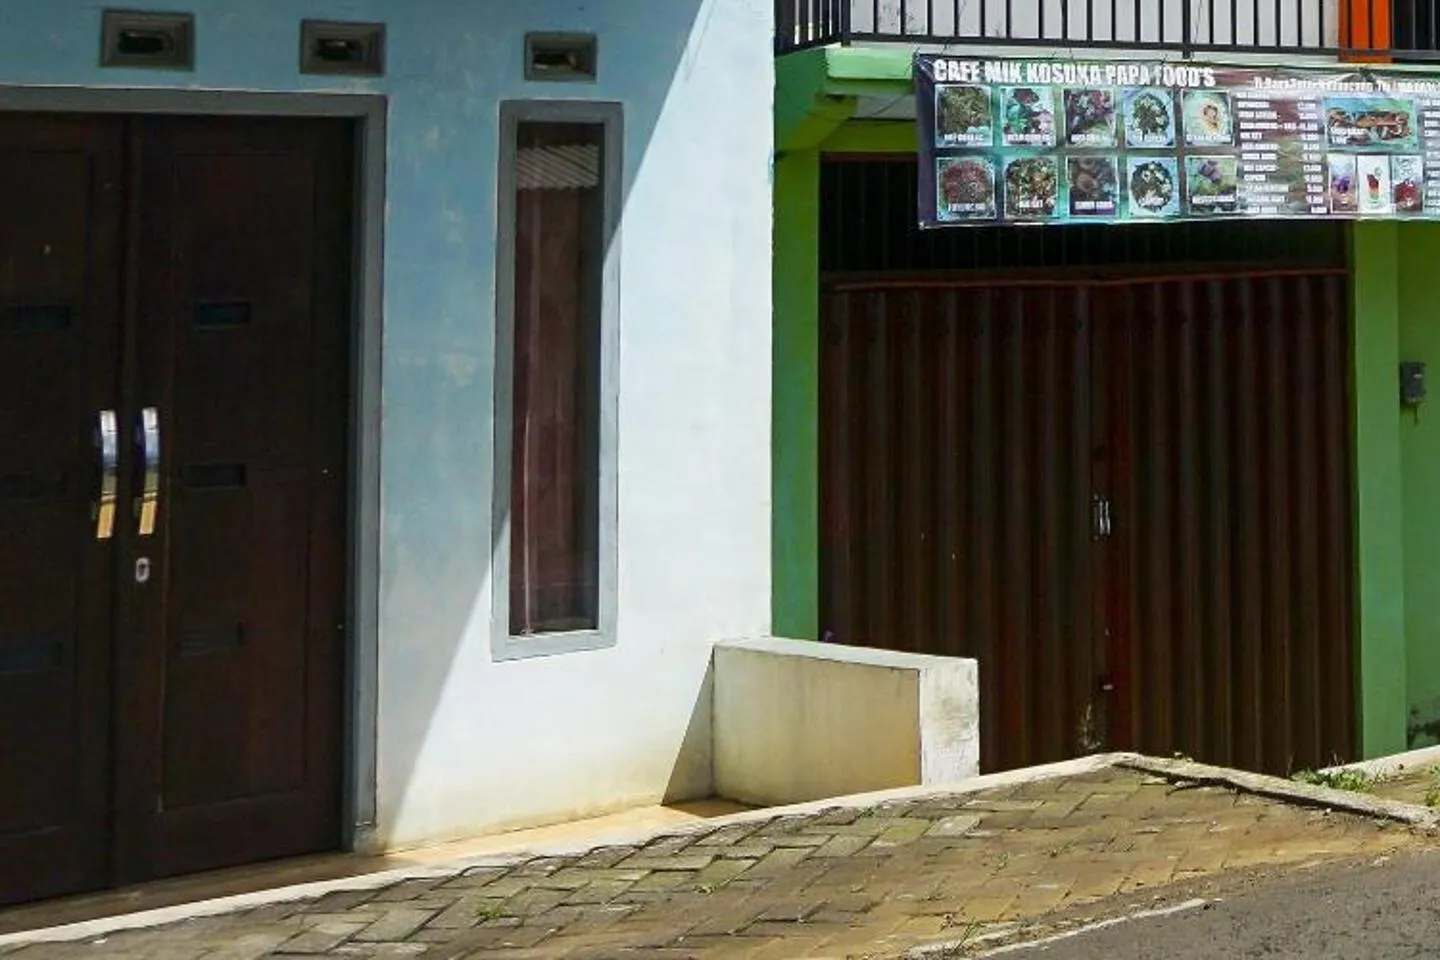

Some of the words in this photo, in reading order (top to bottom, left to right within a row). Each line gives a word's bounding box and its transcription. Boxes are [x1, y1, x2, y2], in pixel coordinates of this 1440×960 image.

[933, 59, 981, 82] CAFE
[984, 60, 1022, 83] MIK
[1026, 62, 1102, 86] KOSUKA
[1105, 64, 1151, 86] PAPA
